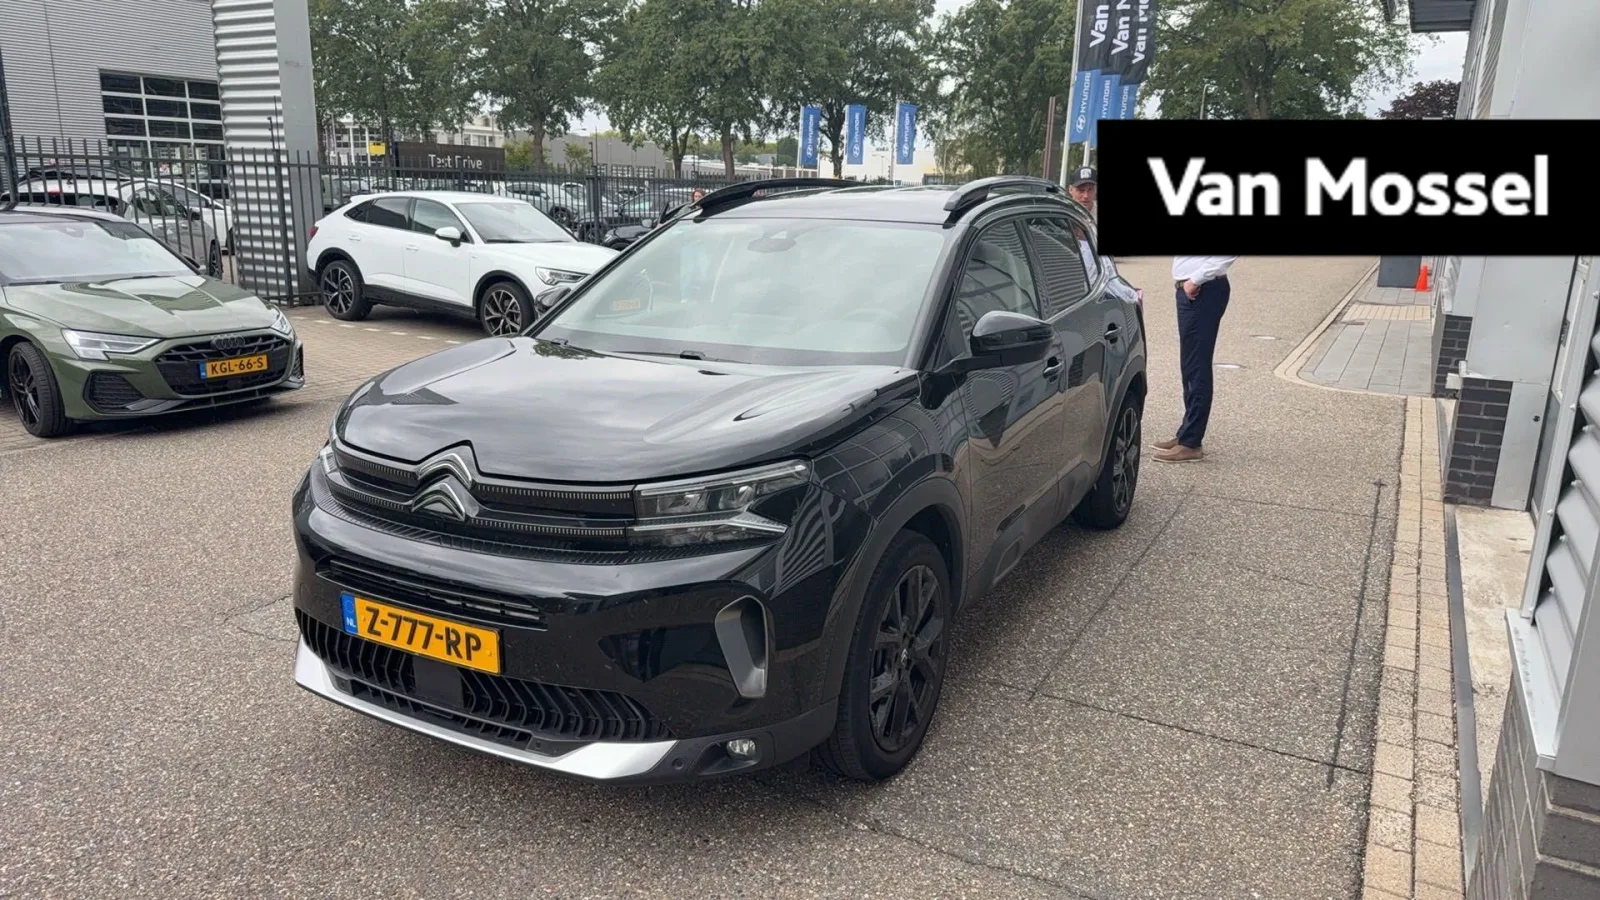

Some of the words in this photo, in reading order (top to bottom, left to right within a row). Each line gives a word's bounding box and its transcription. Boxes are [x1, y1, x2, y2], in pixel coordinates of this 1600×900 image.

[1089, 4, 1110, 48] Van
[1111, 16, 1130, 55] Van
[1080, 72, 1092, 113] HYUNDAI
[428, 154, 452, 168] Test
[210, 357, 264, 375] KGL-66-S
[346, 618, 357, 628] NL
[365, 605, 482, 662] Z-777-RP
